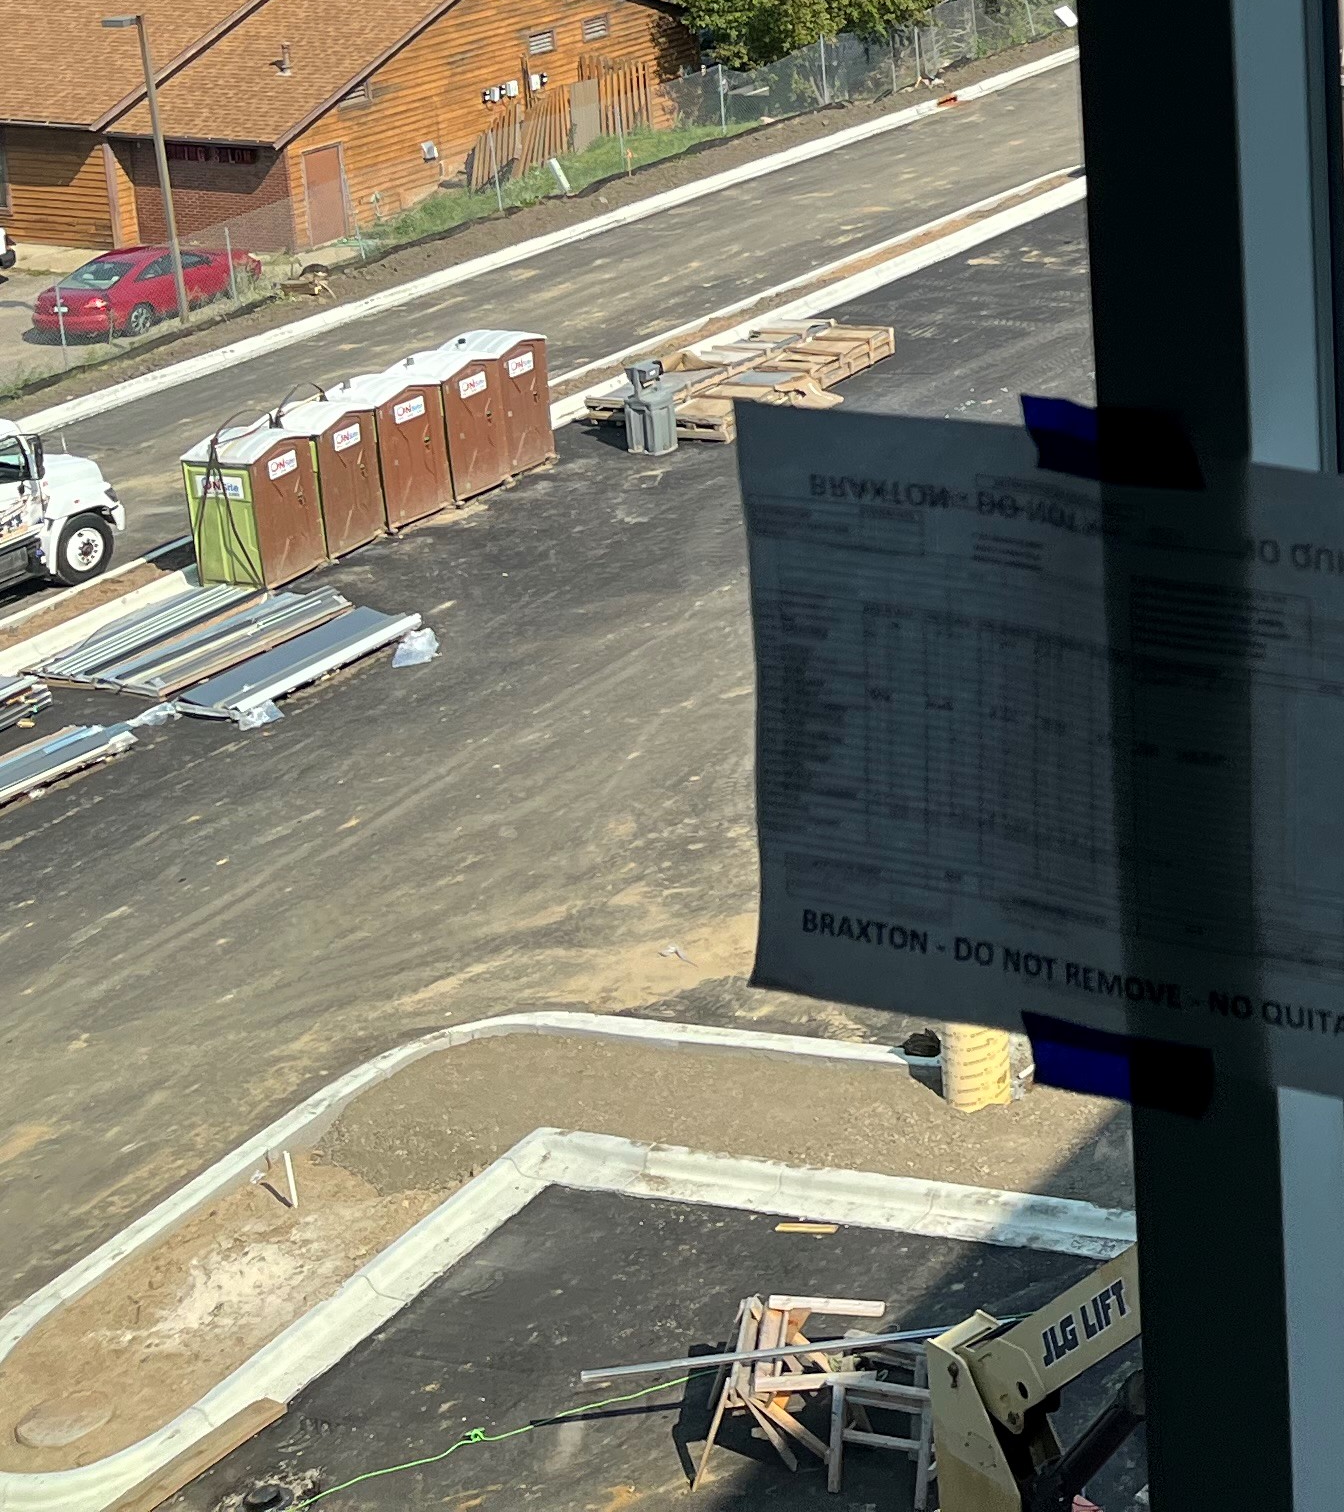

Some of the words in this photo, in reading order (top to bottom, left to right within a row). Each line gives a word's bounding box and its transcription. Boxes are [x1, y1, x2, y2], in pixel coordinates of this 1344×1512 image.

[802, 908, 928, 955] BRAXTON
[953, 936, 994, 966] DO
[1003, 946, 1057, 980] NOT
[1065, 961, 1182, 1009] REMOVE
[1208, 990, 1253, 1020] NO
[1041, 1313, 1080, 1368] JLG
[1080, 1278, 1128, 1341] LIFT
